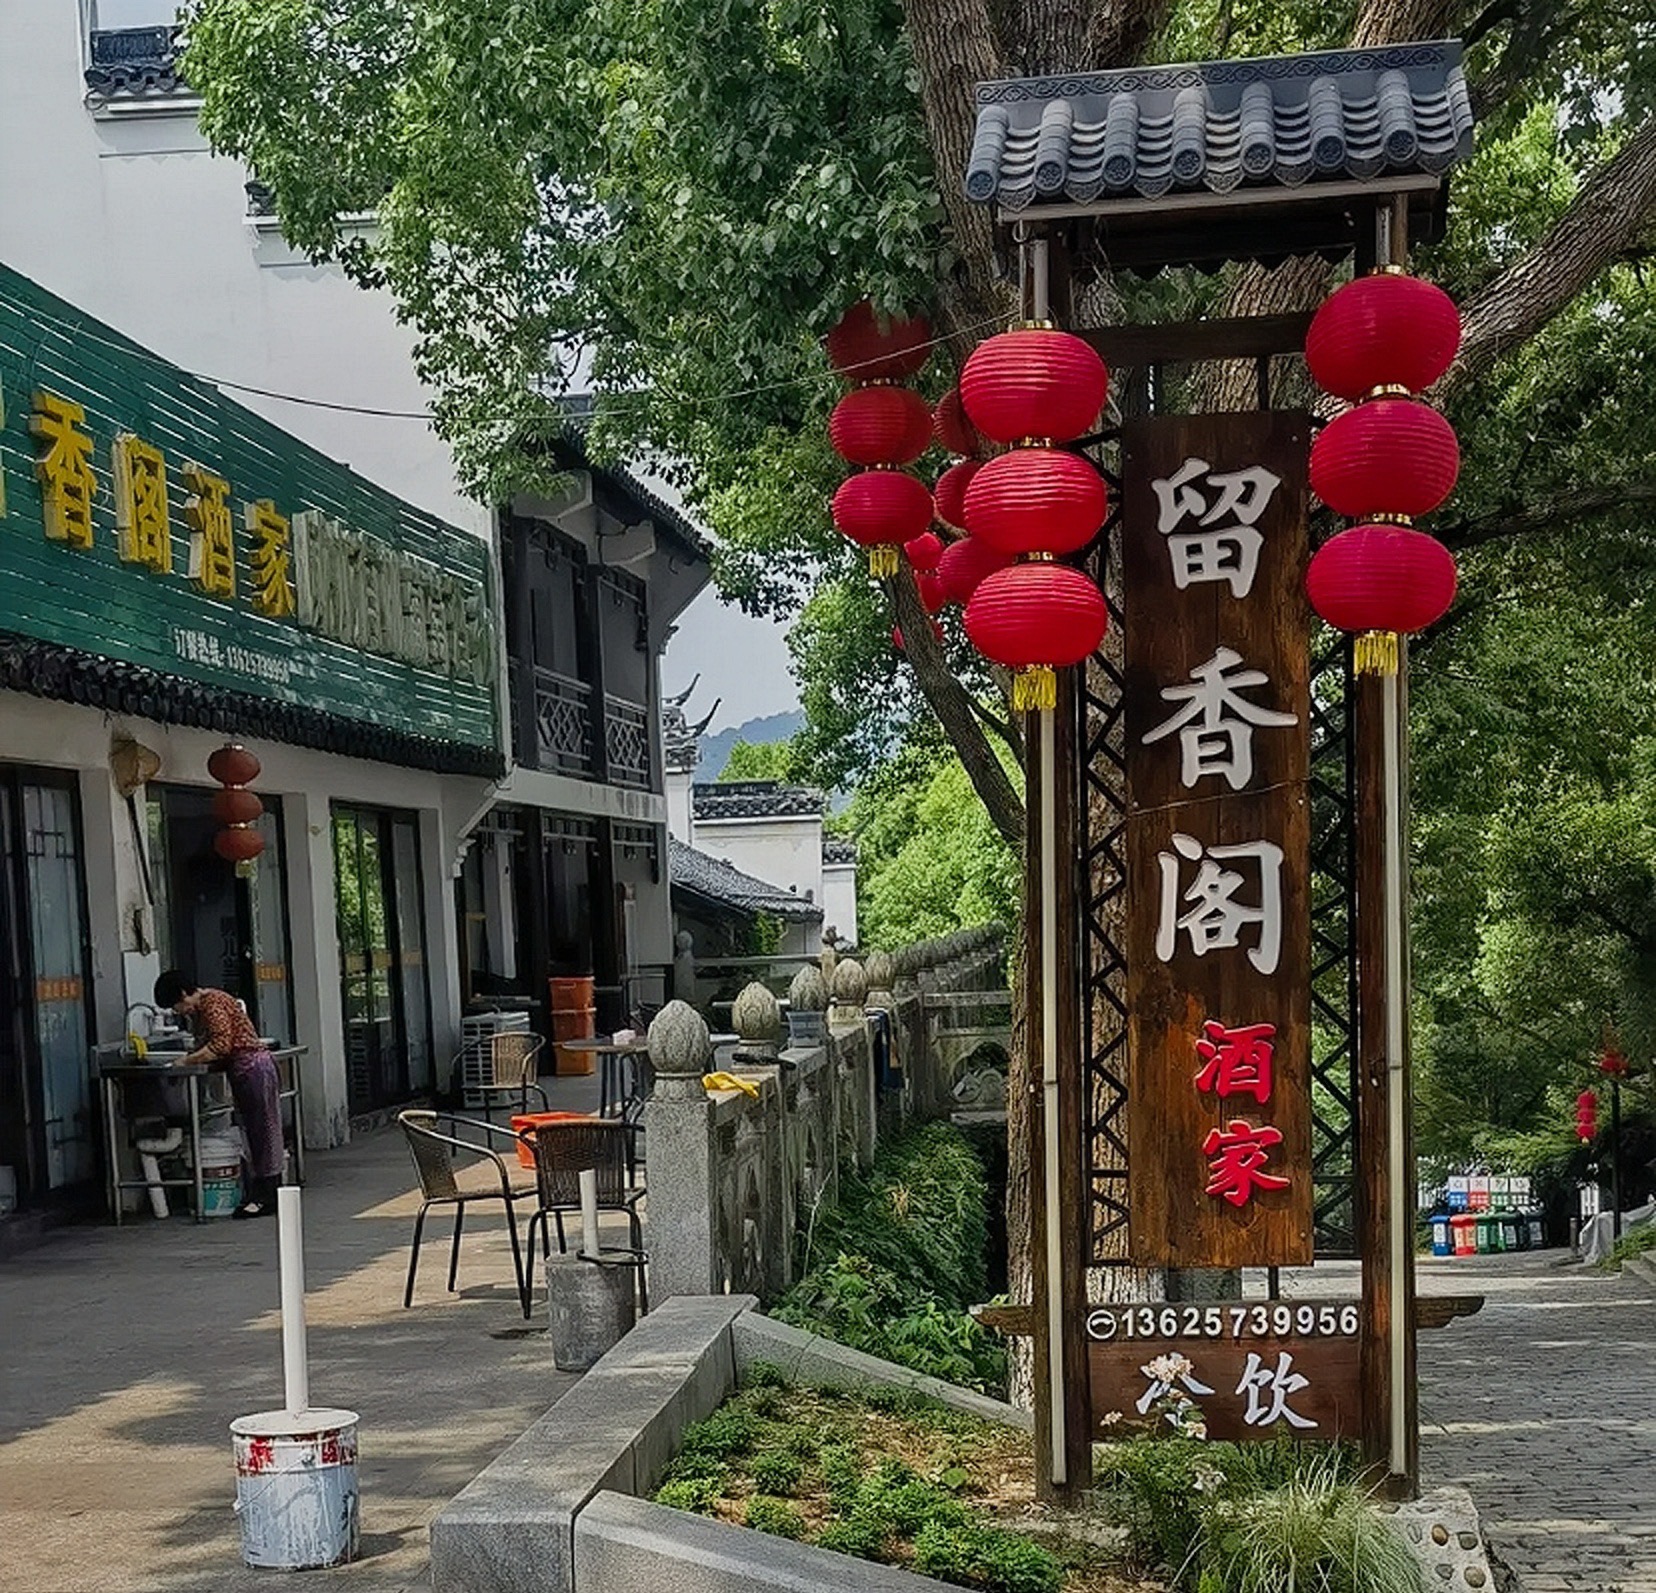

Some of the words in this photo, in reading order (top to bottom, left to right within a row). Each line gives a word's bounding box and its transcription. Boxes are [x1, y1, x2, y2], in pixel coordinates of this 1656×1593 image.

[0, 383, 296, 618] 香阁酒家
[1121, 1306, 1358, 1337] 13625739956
